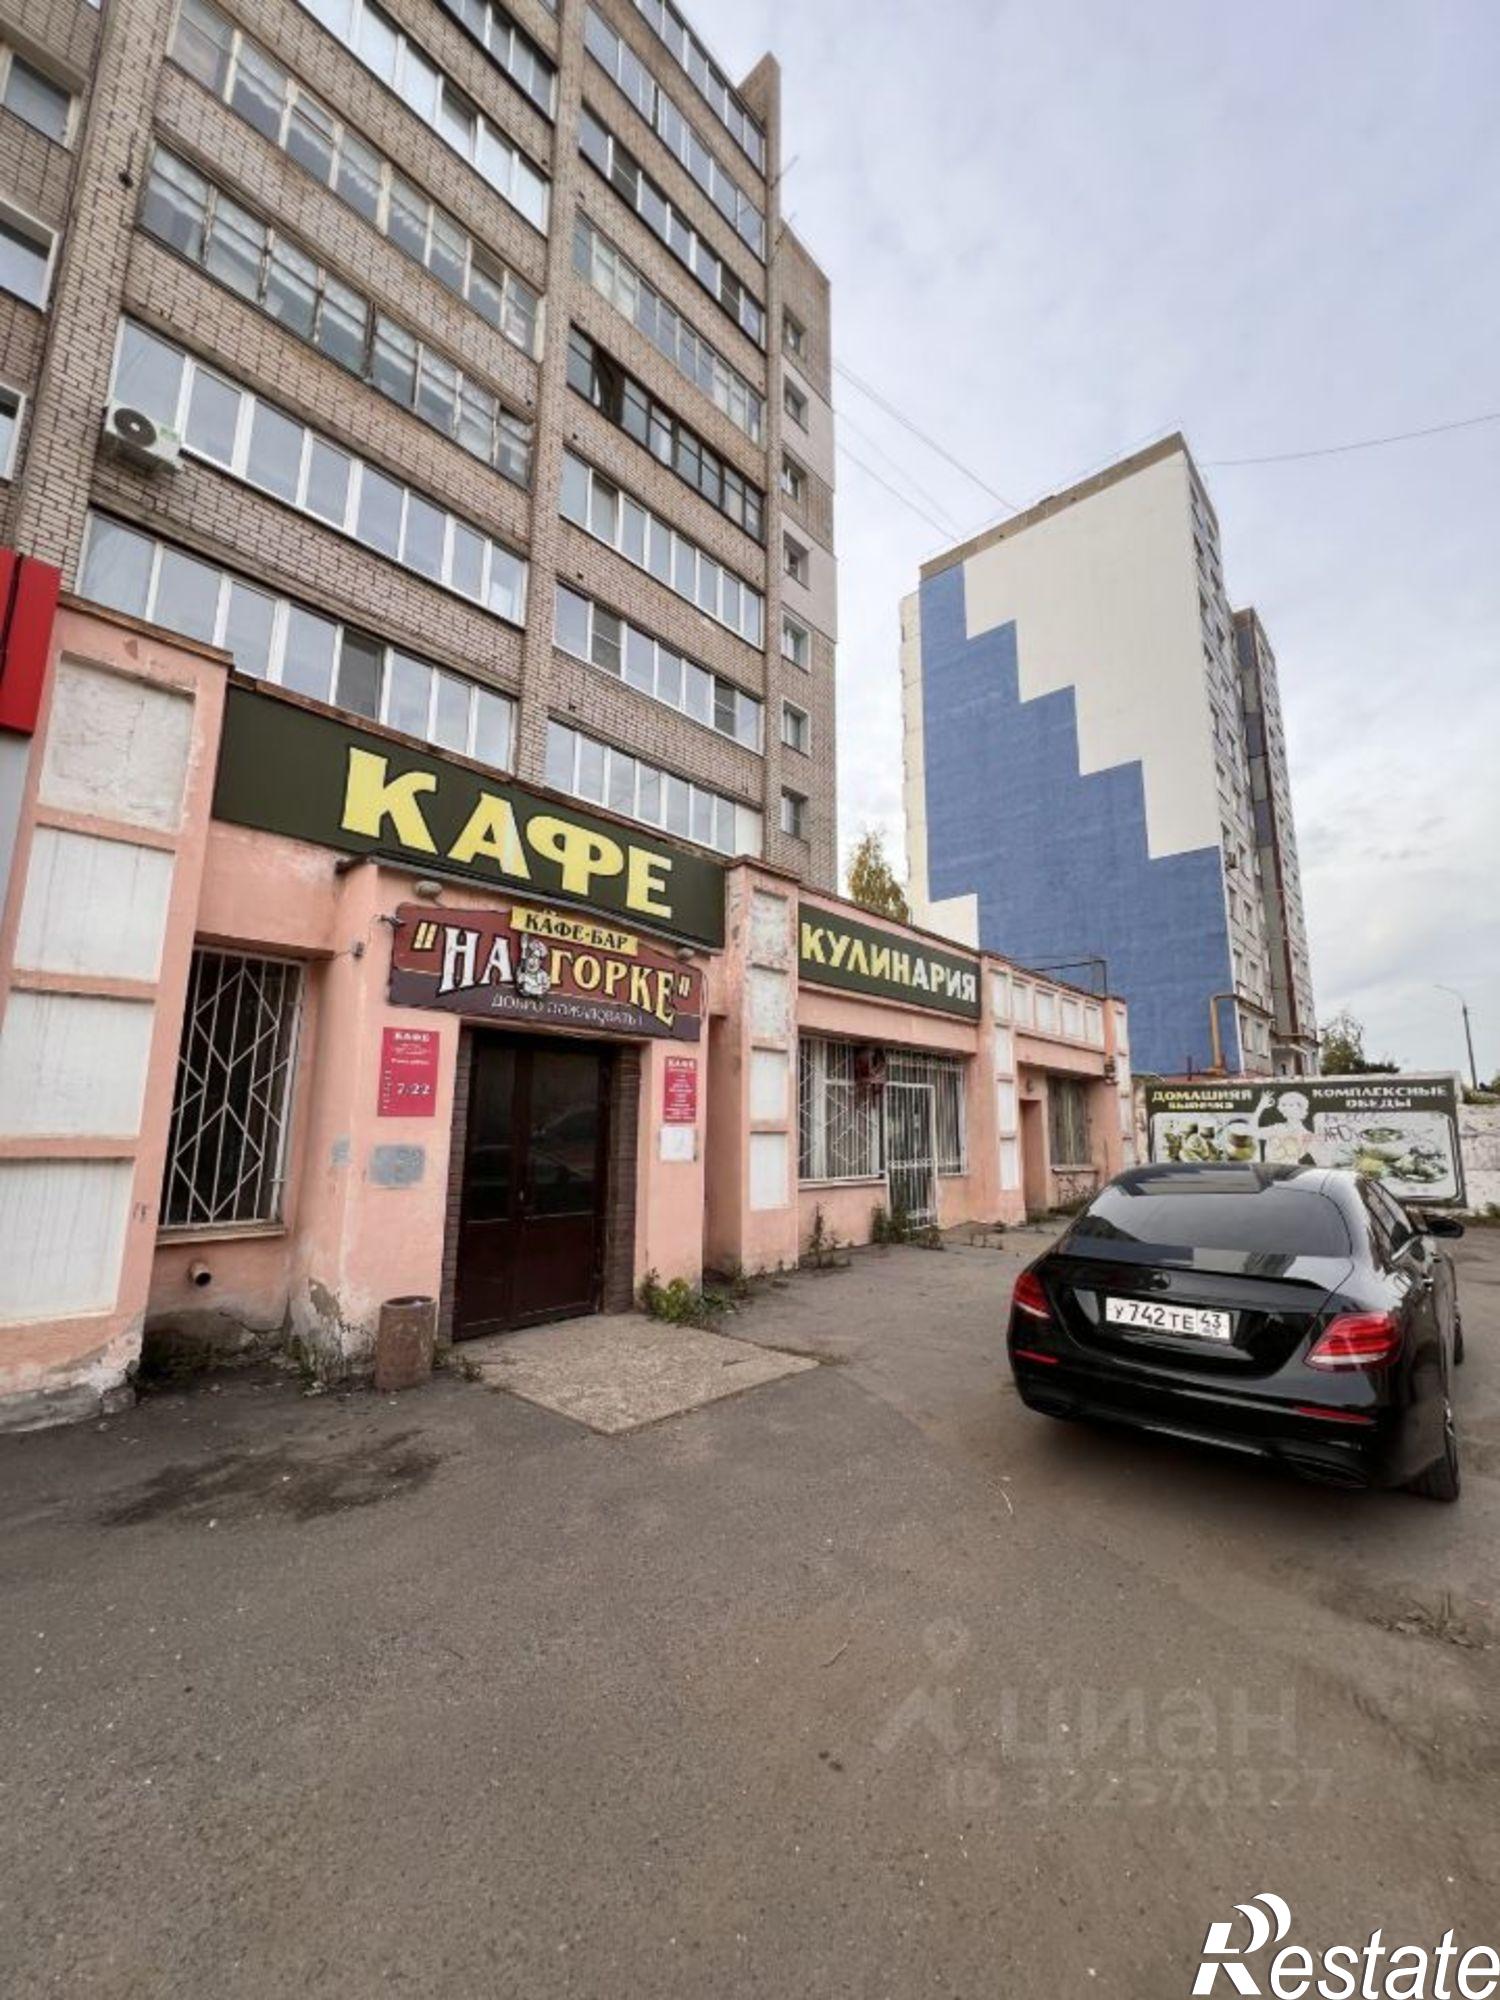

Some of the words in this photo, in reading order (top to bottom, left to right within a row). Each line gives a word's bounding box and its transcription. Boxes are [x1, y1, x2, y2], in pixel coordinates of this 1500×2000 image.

[341, 746, 672, 919] КАФЕ
[524, 913, 628, 948] КАФЕ-БАР
[801, 922, 976, 1003] КУЛИНАРИЯ
[1312, 1086, 1448, 1099] КОМПЛЕКСНЫЕ
